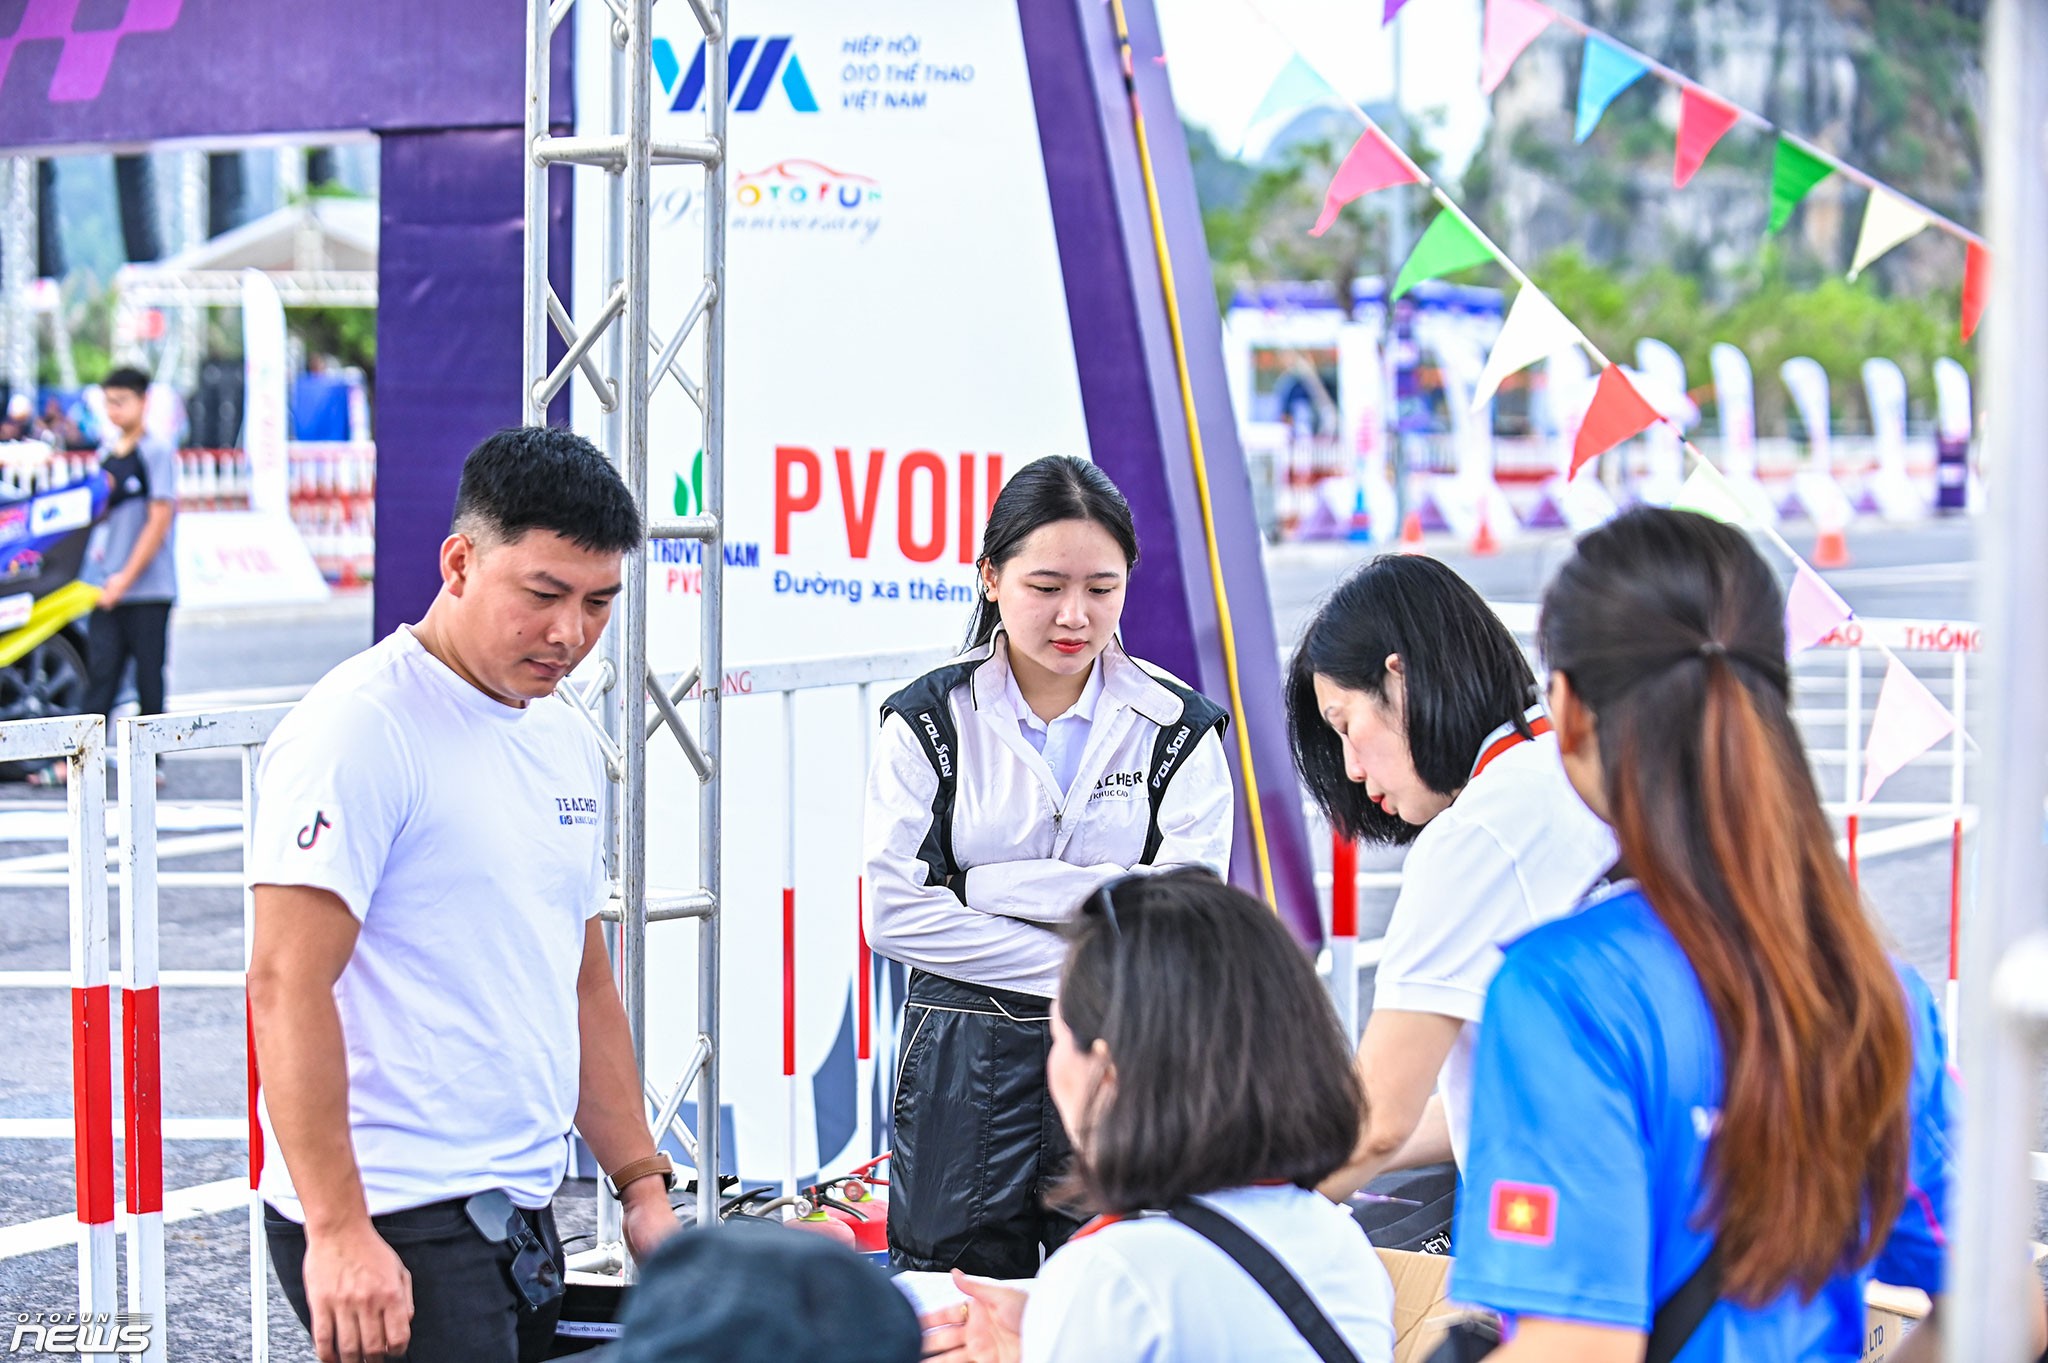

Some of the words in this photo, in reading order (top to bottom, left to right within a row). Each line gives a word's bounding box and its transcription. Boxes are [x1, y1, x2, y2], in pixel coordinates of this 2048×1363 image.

[884, 92, 928, 108] NAM
[773, 571, 863, 603] Đường
[871, 581, 900, 600] xa
[908, 577, 973, 603] thêm
[919, 712, 953, 778] VOLSON
[1152, 724, 1191, 788] VOLSON
[1094, 771, 1143, 790] ACHER
[1869, 1324, 1884, 1352] LTD
